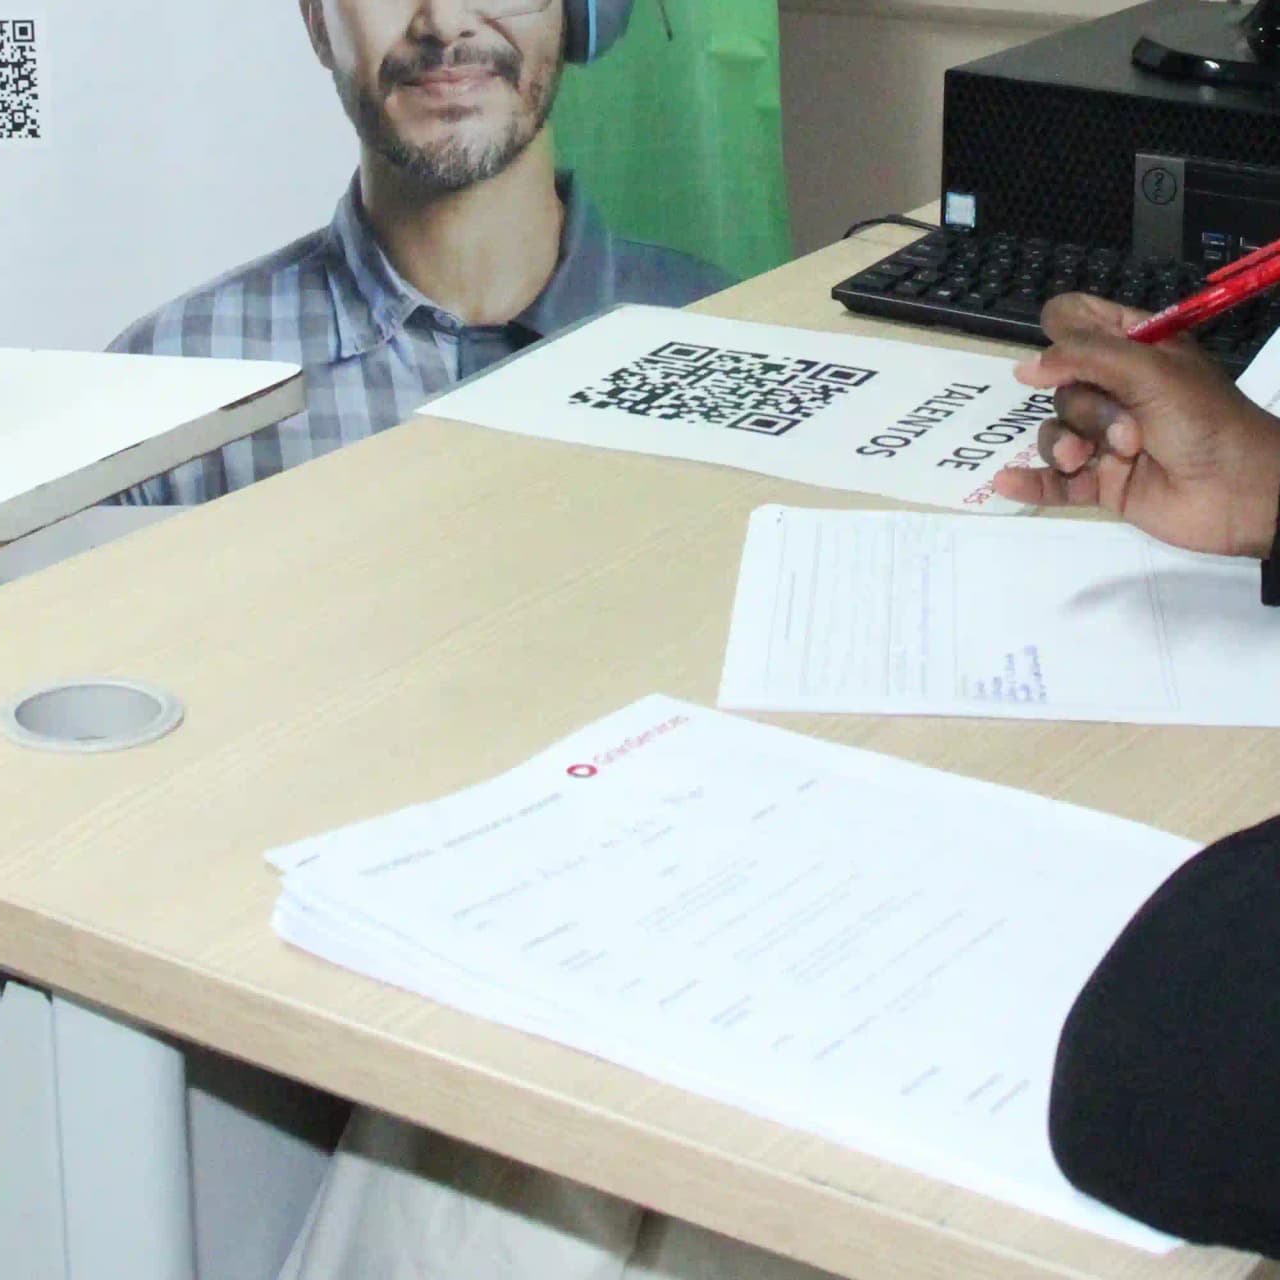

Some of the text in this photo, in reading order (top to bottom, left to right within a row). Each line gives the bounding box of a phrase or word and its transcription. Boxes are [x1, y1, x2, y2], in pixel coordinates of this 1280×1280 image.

[856, 382, 991, 458] TALENTOS
[936, 393, 1054, 471] BANCO DE
